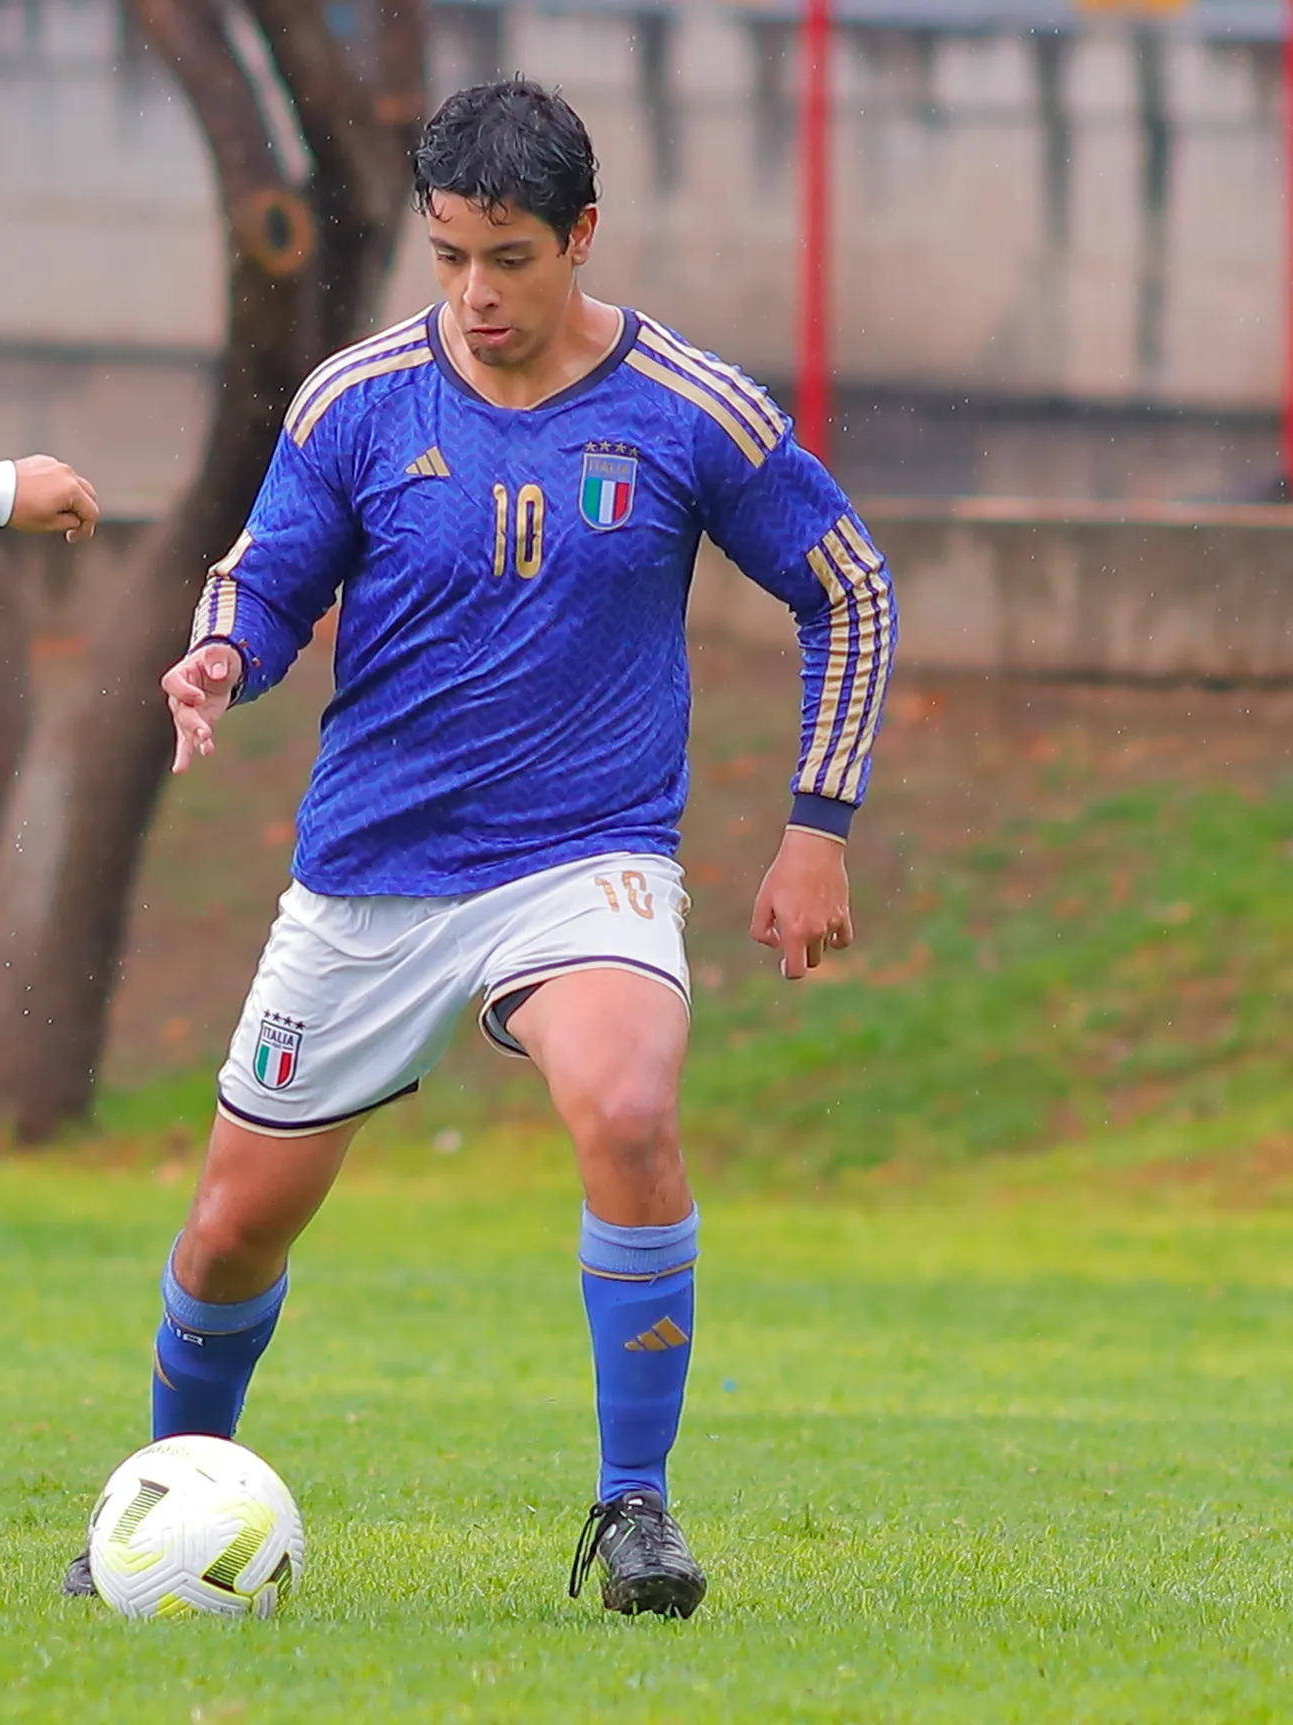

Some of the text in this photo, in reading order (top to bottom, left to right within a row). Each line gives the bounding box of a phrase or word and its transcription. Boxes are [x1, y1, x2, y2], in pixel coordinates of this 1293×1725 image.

[587, 459, 631, 475] ITALIA
[493, 484, 544, 579] 10
[595, 870, 654, 919] 10
[262, 1025, 294, 1047] ITALIA
